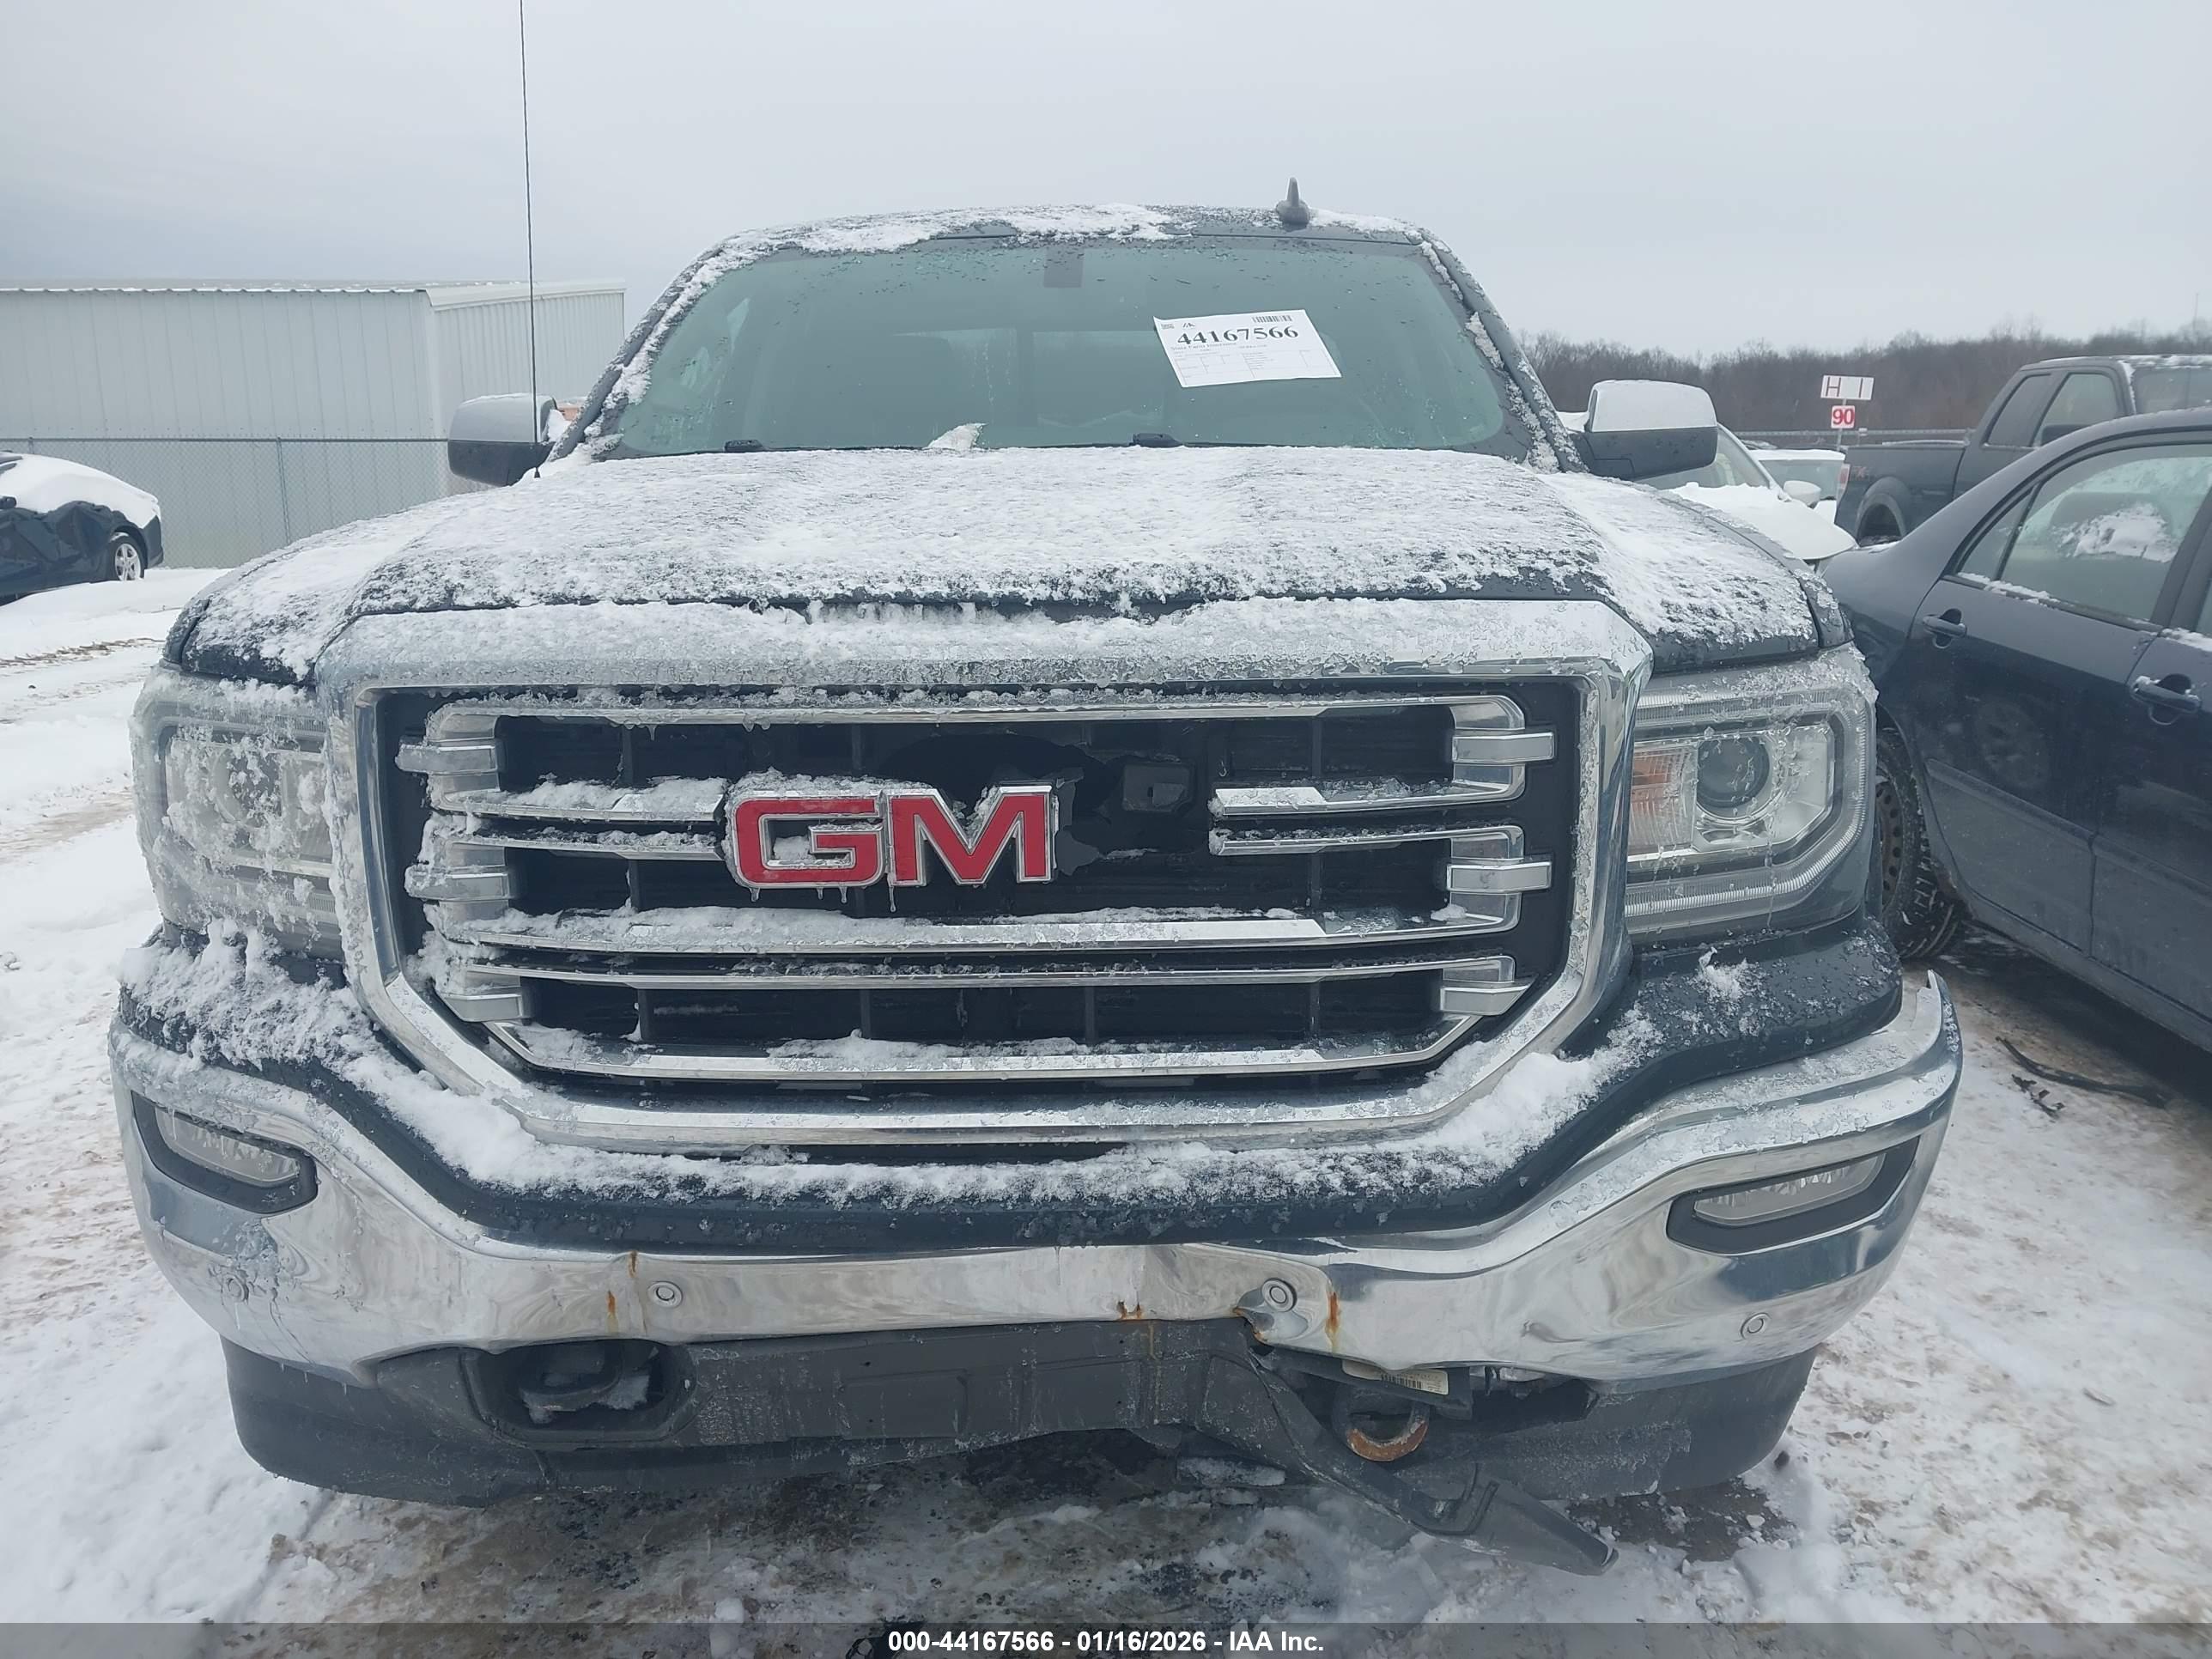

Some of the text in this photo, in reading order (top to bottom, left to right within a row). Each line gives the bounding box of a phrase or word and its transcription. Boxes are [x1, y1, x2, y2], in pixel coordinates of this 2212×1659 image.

[1176, 325, 1299, 345] 44167566
[1826, 376, 1842, 397] H
[1832, 408, 1855, 425] 90
[728, 784, 1056, 886] GM
